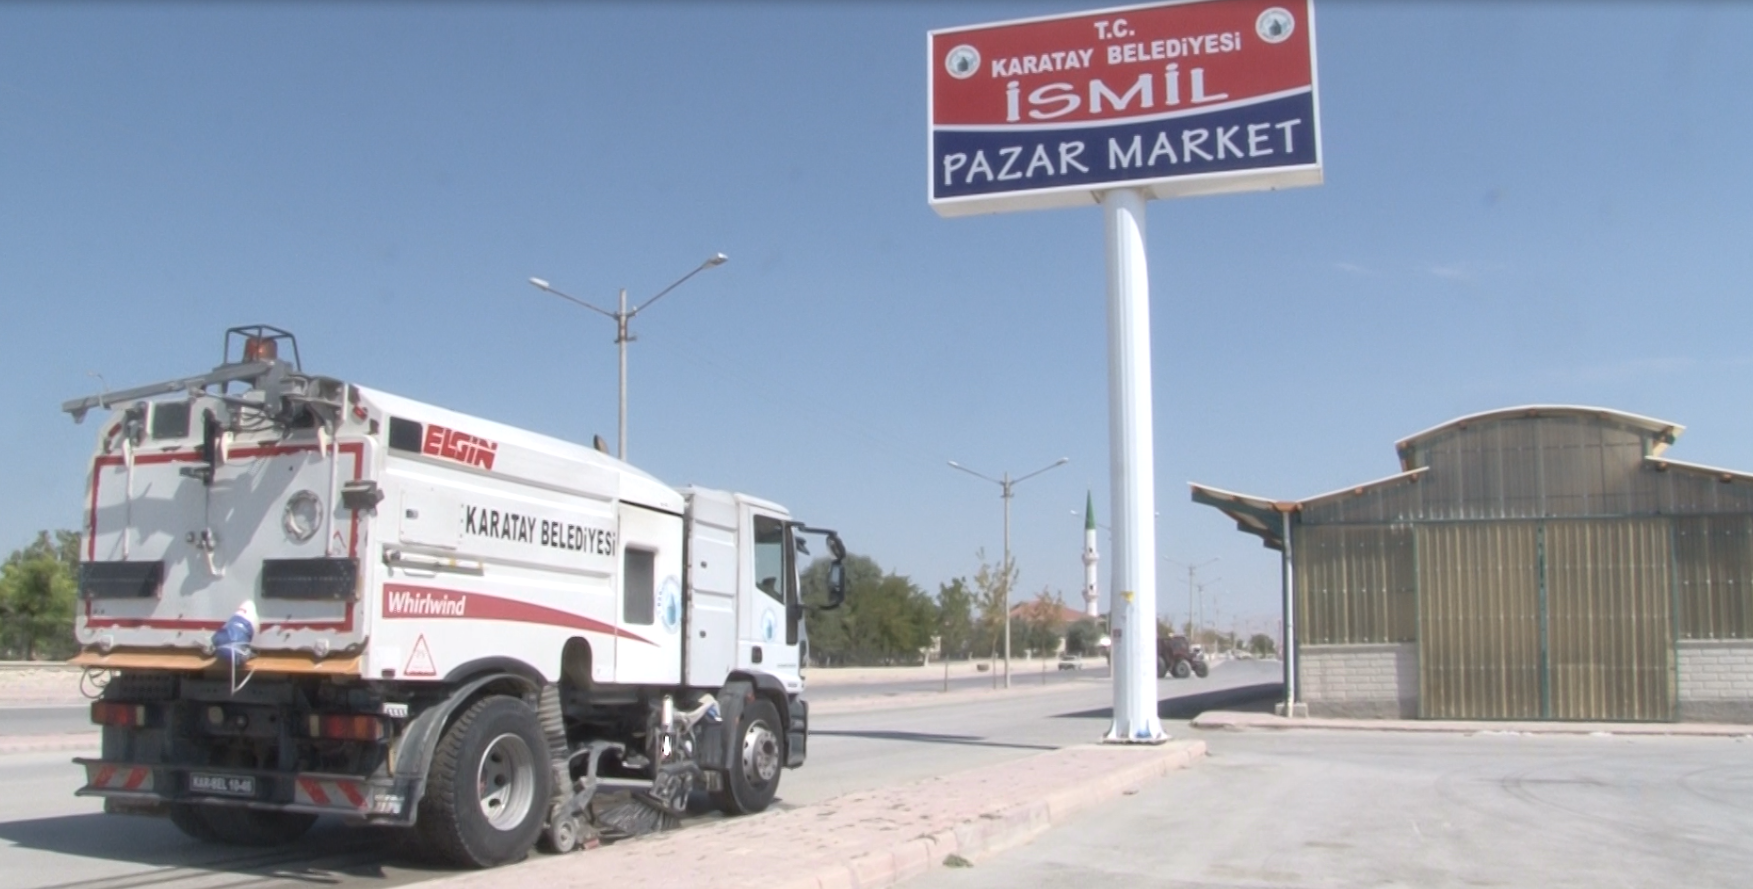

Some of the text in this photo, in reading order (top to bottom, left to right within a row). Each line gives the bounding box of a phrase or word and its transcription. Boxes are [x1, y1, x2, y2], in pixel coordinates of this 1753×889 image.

[1095, 19, 1135, 39] T.C.
[991, 48, 1094, 78] KARATAY
[943, 119, 1301, 185] PAZAR MARKET
[465, 504, 536, 544] KARATAY
[388, 590, 466, 616] Whirlwind
